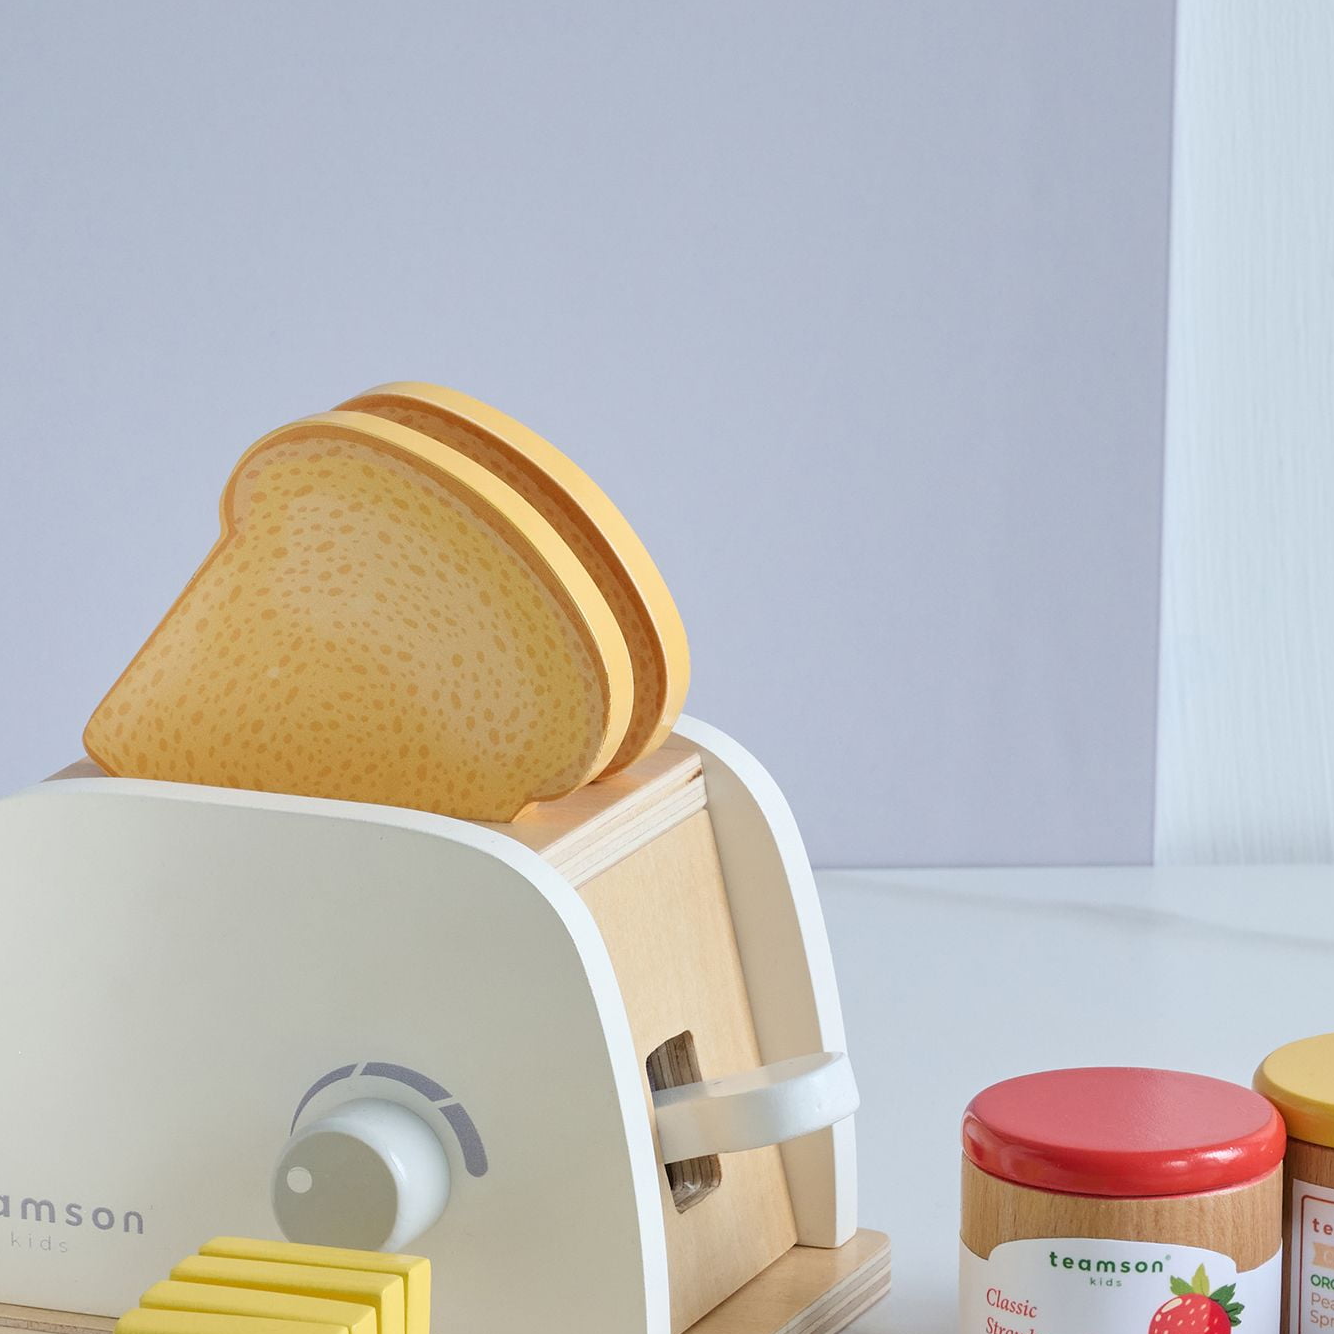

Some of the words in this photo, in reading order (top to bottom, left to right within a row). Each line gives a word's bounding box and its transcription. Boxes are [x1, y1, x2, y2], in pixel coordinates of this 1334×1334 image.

[10, 1231, 69, 1254] kids
[1049, 1251, 1165, 1274] teamson
[1089, 1276, 1123, 1288] kids
[985, 1287, 1038, 1319] Classic
